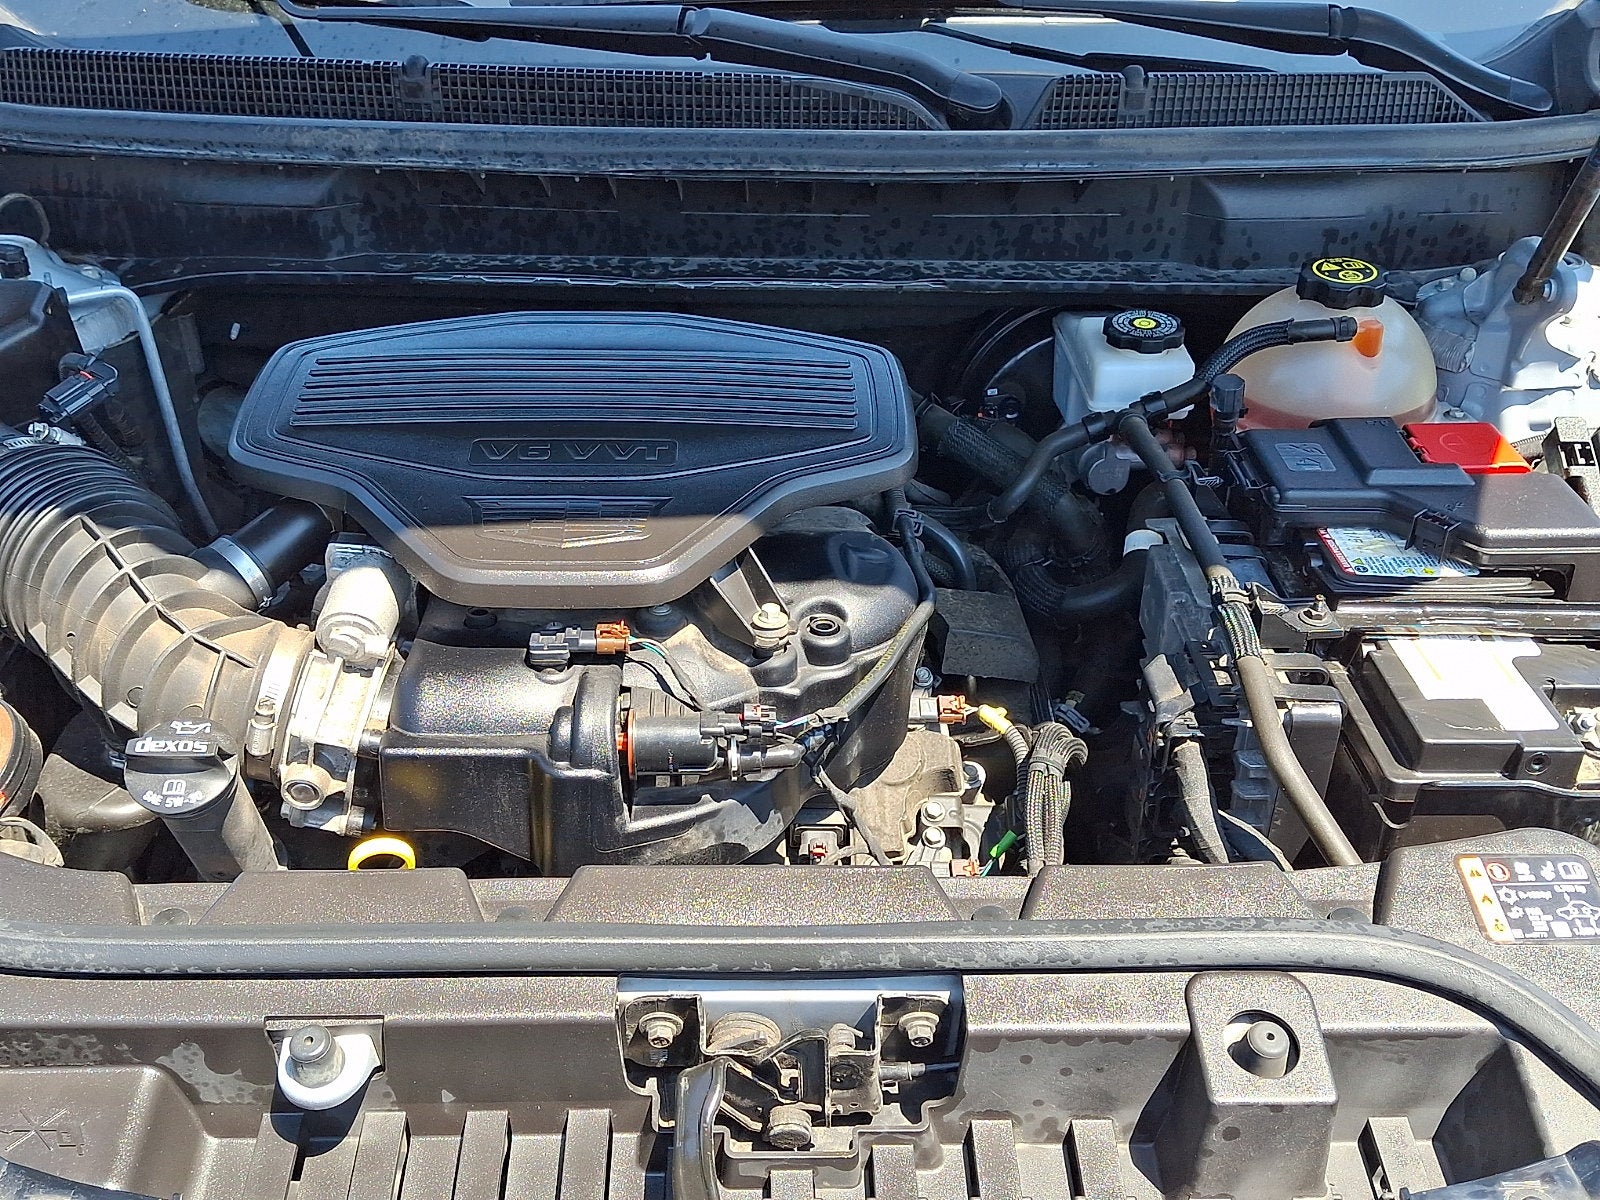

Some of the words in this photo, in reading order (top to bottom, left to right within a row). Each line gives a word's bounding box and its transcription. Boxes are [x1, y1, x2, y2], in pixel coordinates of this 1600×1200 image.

[479, 443, 551, 461] V6
[562, 443, 669, 461] VVT
[135, 737, 209, 753] dexos
